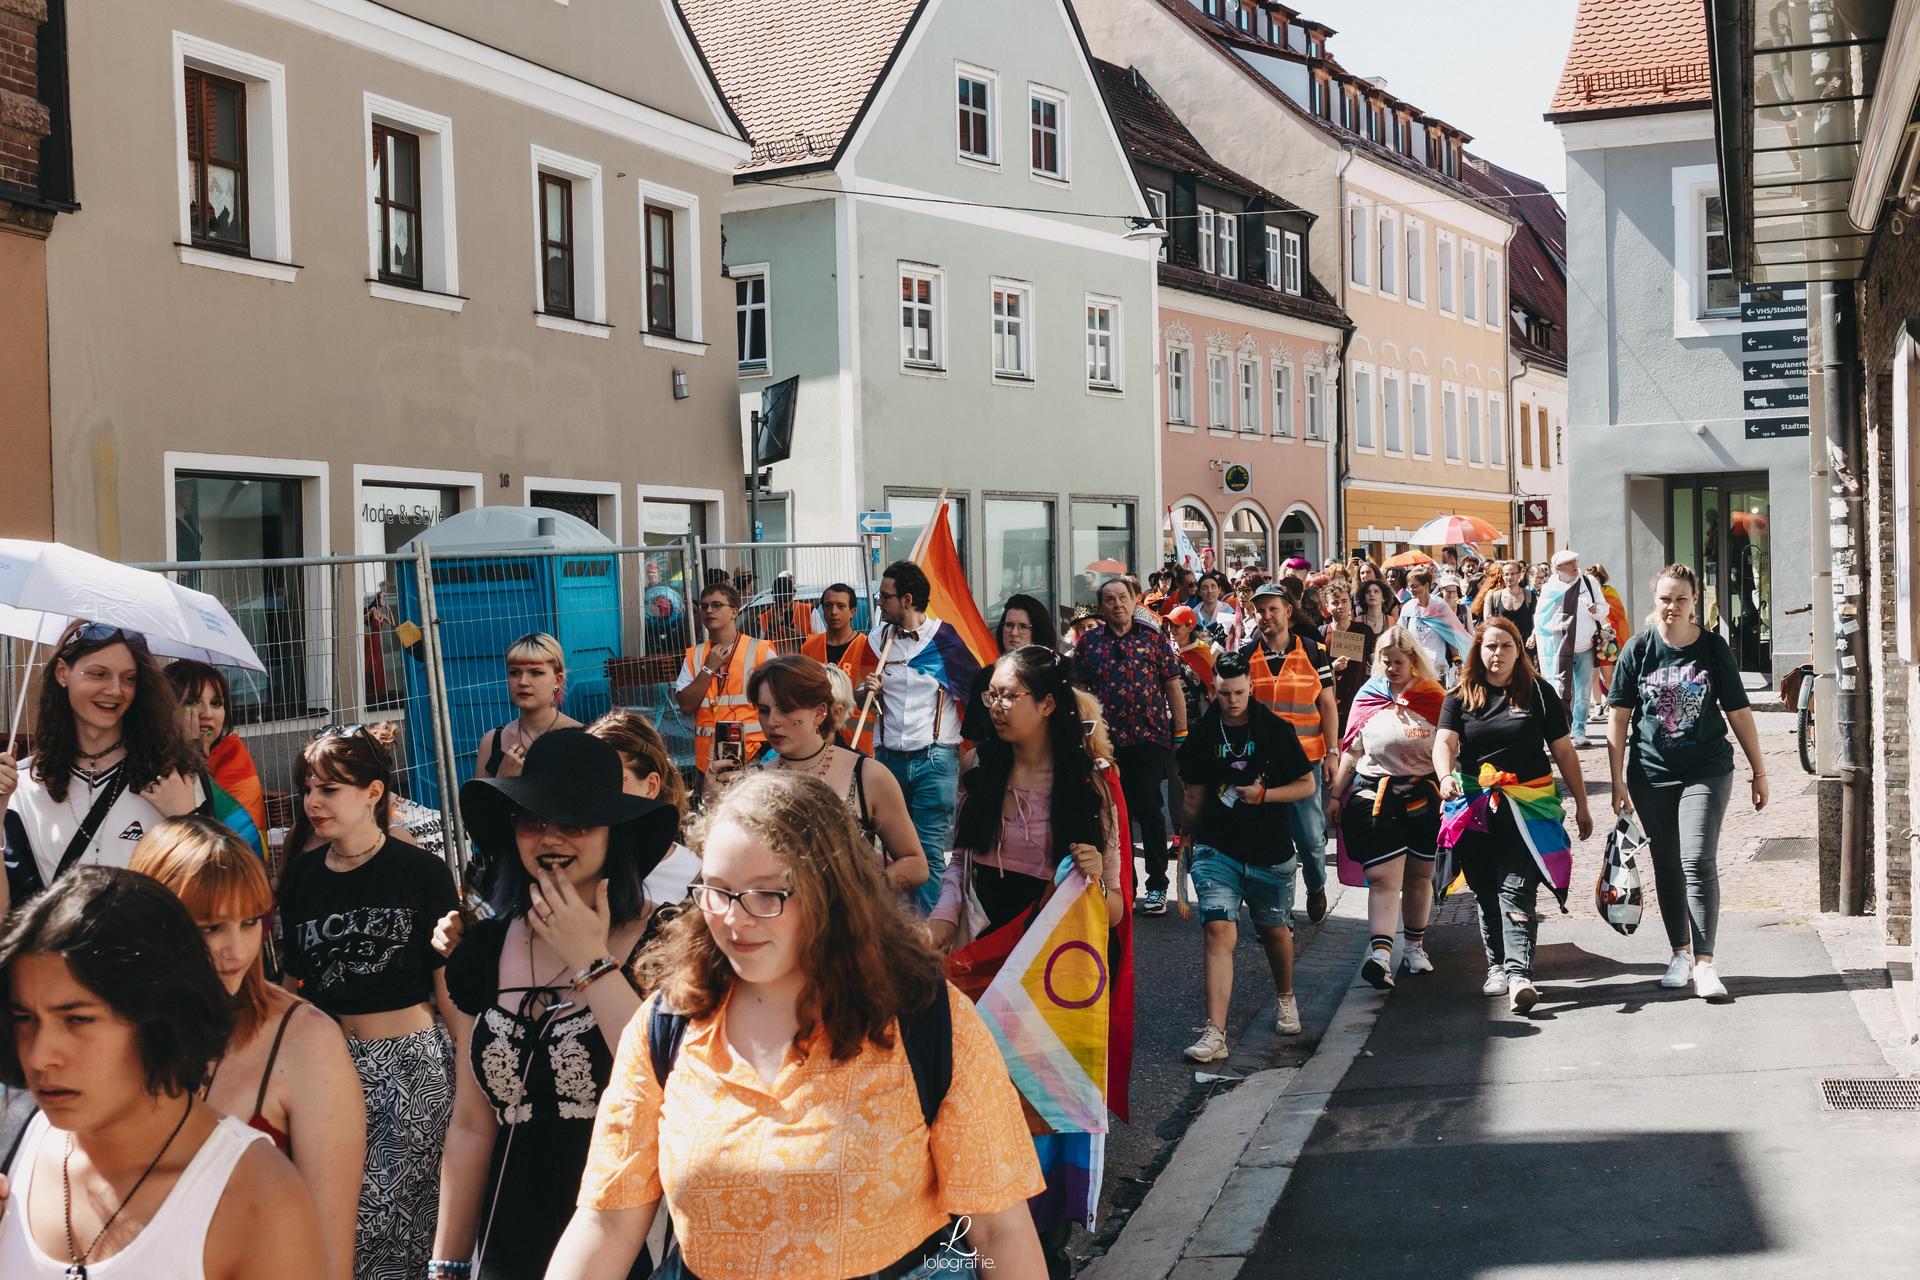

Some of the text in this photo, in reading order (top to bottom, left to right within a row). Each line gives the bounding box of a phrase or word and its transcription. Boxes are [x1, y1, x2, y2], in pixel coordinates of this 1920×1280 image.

[362, 503, 447, 528] Mode & Style
